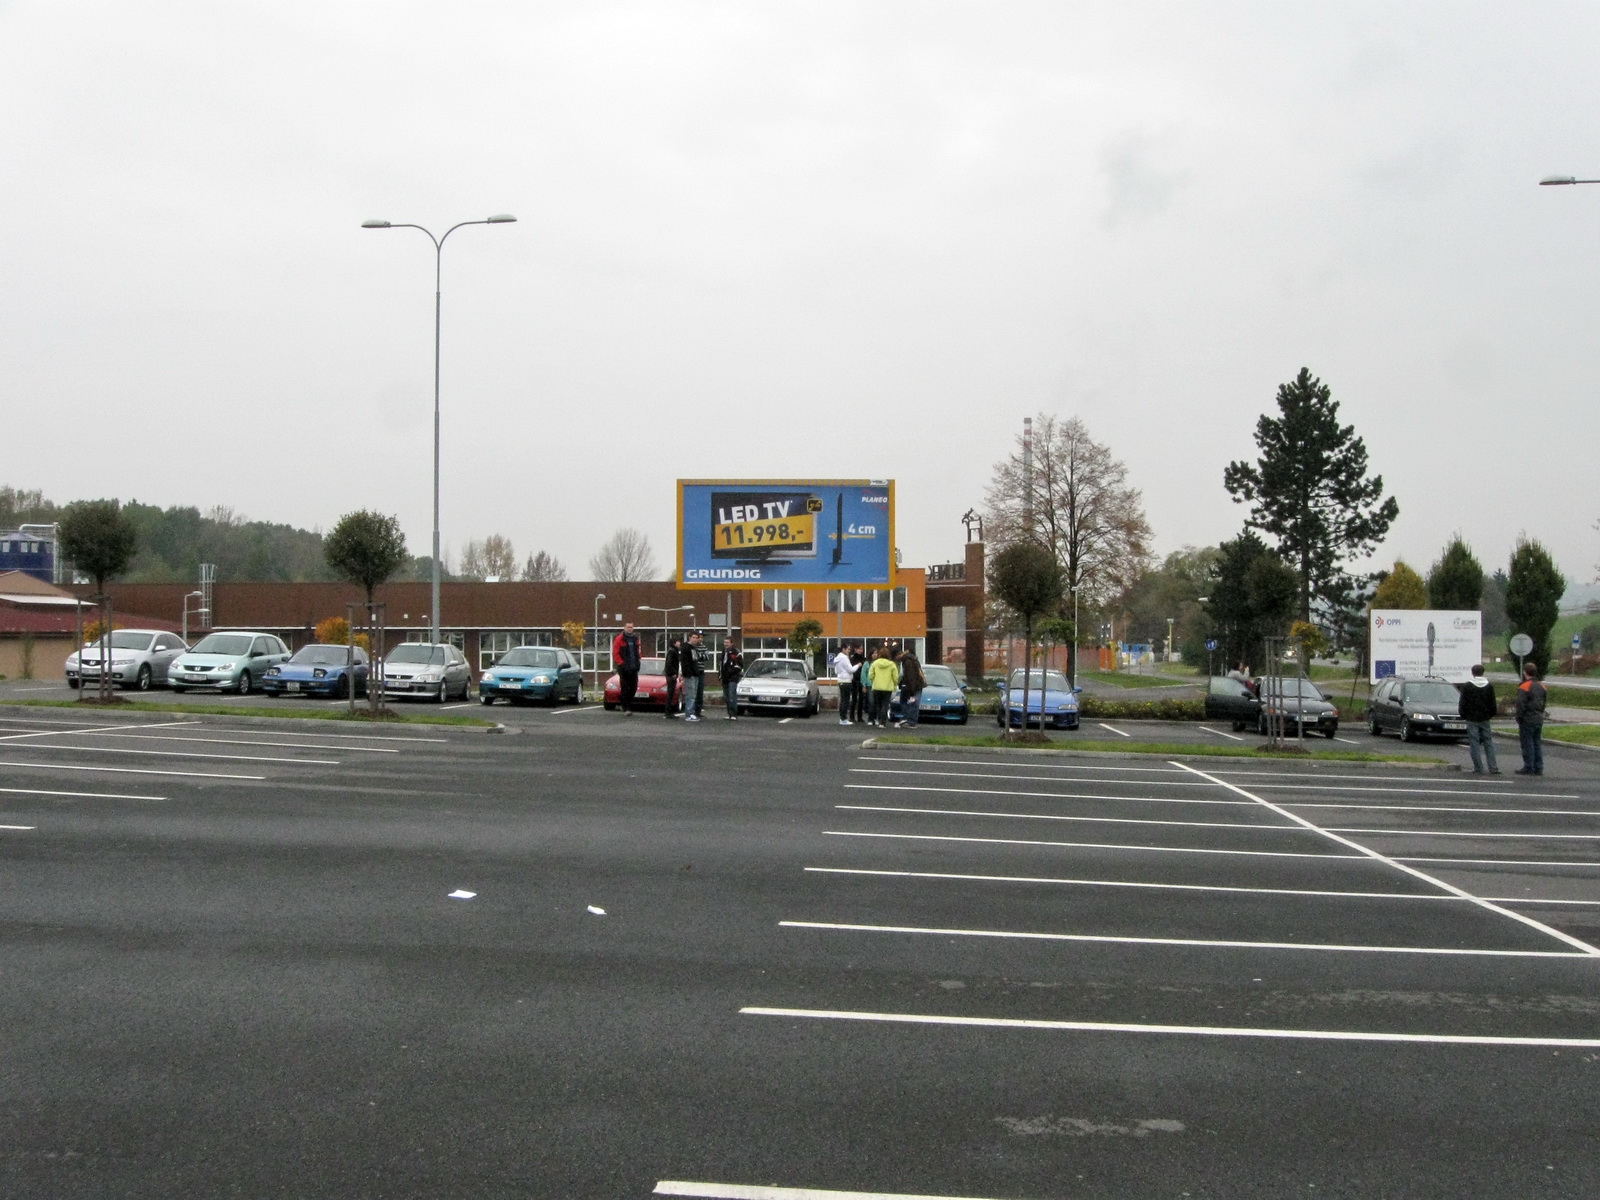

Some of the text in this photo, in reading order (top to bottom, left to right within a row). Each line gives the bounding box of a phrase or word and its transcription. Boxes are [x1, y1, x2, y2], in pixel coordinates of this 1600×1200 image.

[719, 504, 759, 525] LED
[721, 523, 803, 545] 11.998,-
[848, 524, 876, 534] 4 cm
[686, 569, 761, 579] GRUNDIG
[1386, 618, 1401, 626] OPPI
